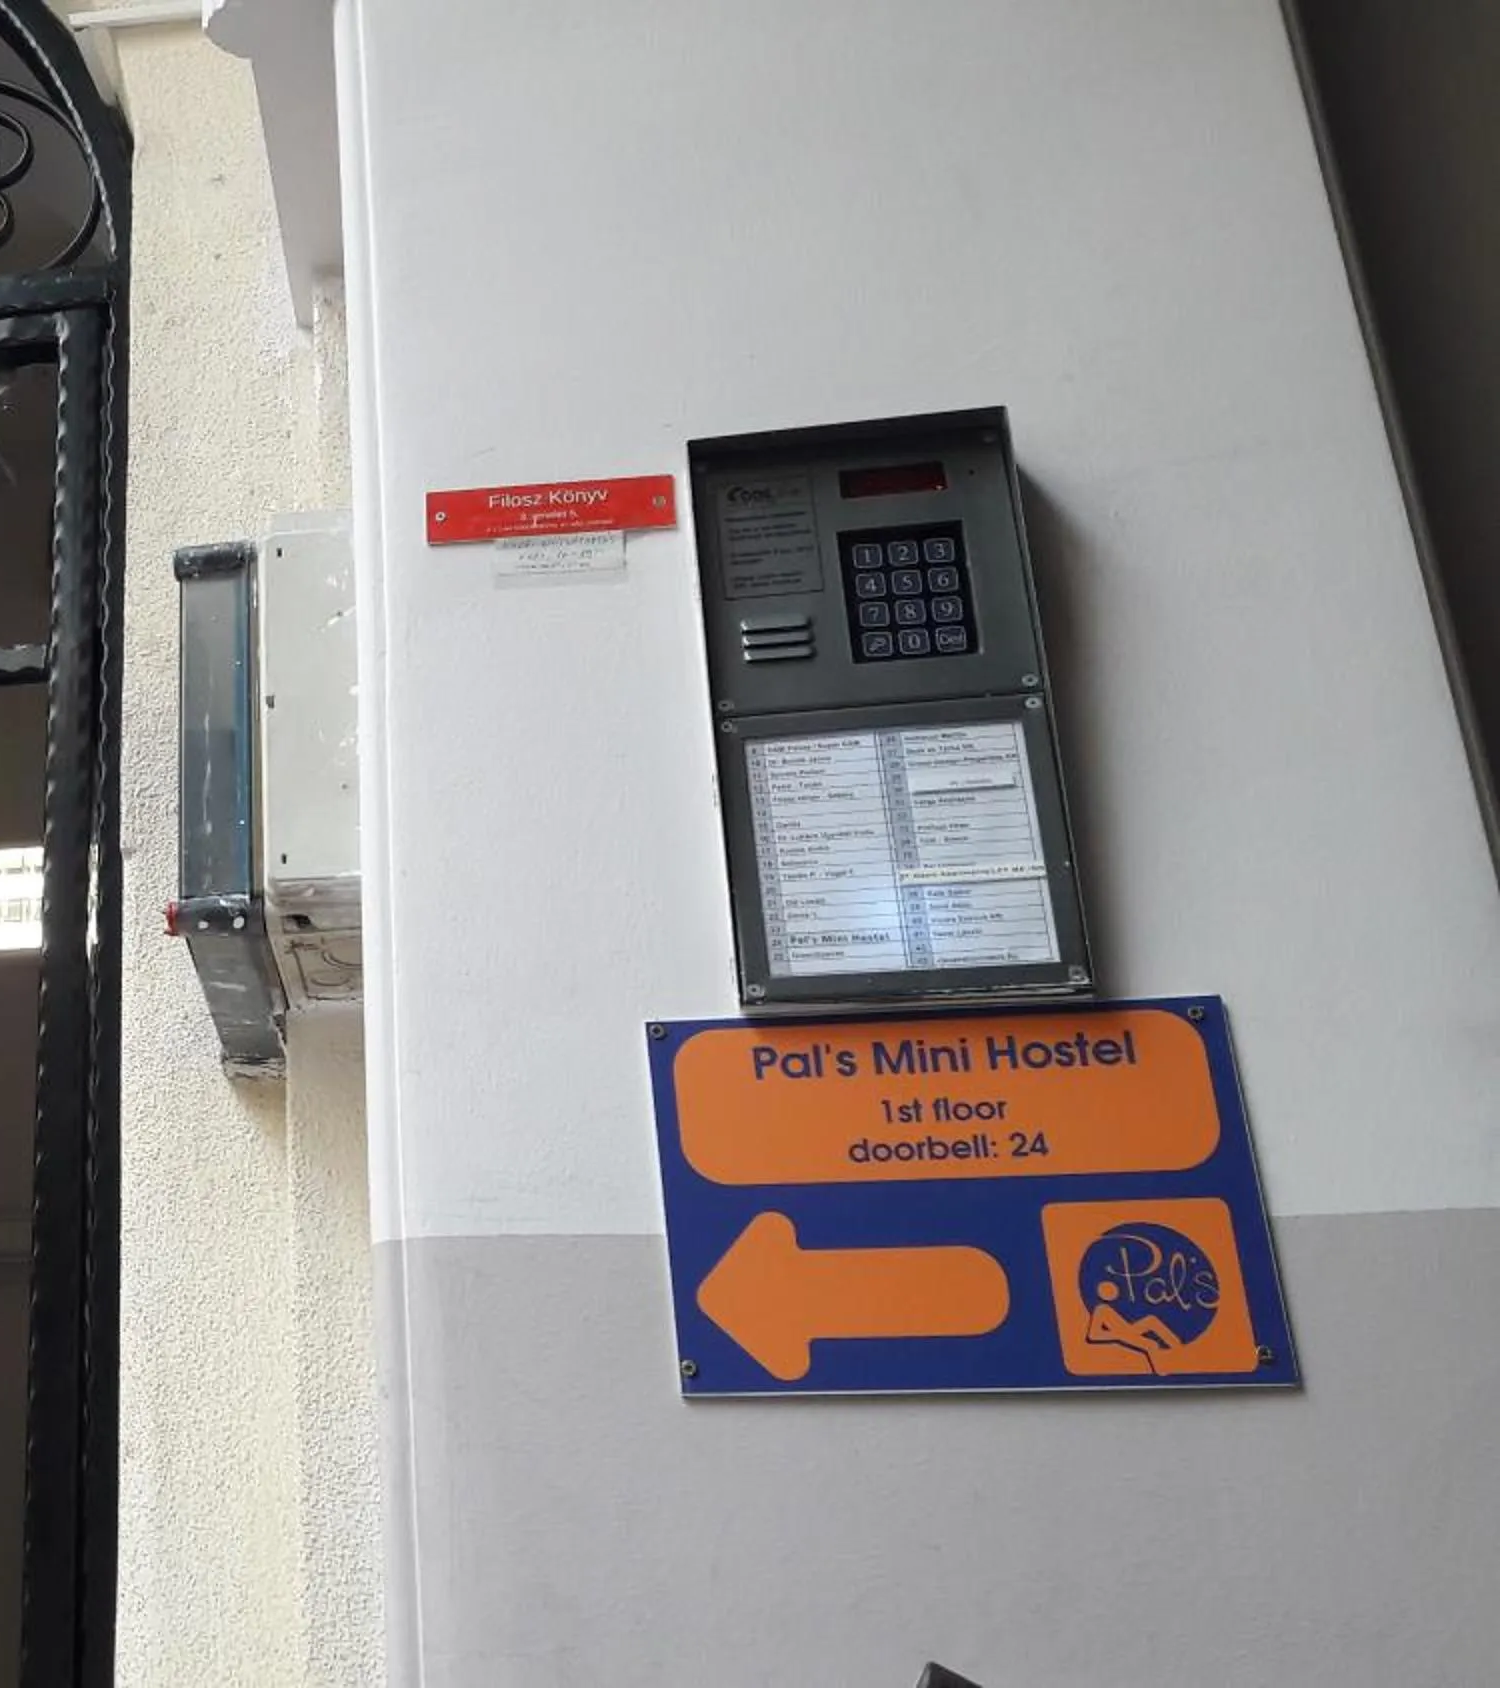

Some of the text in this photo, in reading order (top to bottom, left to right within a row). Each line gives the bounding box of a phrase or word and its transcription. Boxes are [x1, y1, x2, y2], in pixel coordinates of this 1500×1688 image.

[488, 487, 609, 509] Filosz Könyv
[864, 543, 945, 563] 1 2 3
[865, 573, 949, 592] 4 5 6
[904, 603, 915, 619] 8
[941, 602, 953, 617] 9
[908, 634, 920, 649] 0
[751, 1030, 1137, 1081] Pal's Mini Hostel
[881, 1097, 1007, 1124] 1st floor
[848, 1131, 1049, 1163] doorbell: 24
[1100, 1234, 1221, 1311] Pal's
